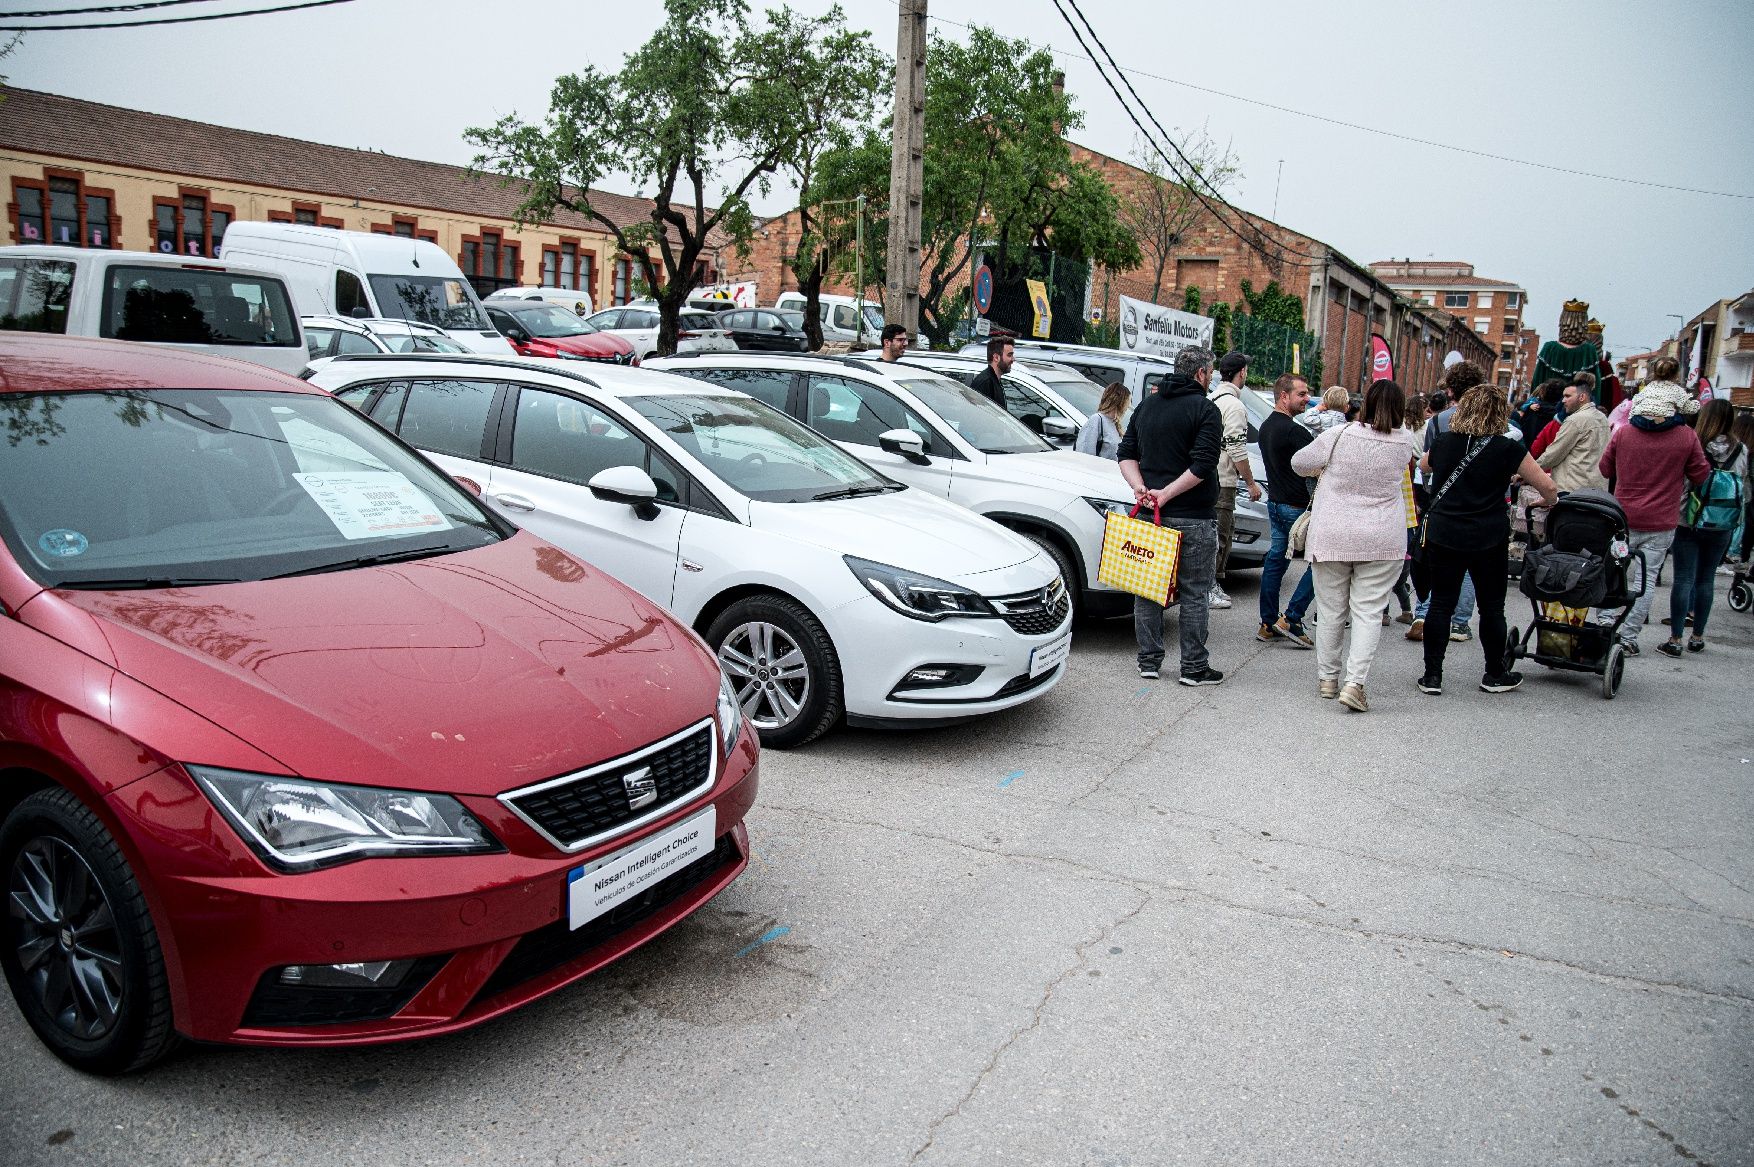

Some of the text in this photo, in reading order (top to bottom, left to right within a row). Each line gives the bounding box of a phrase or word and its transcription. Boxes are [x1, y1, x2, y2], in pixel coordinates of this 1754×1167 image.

[1174, 320, 1199, 340] Motors
[1121, 540, 1155, 559] ANETO
[594, 830, 699, 892] Nissan Intelligent Choice
[627, 880, 635, 889] de
[661, 845, 698, 870] Garantizados
